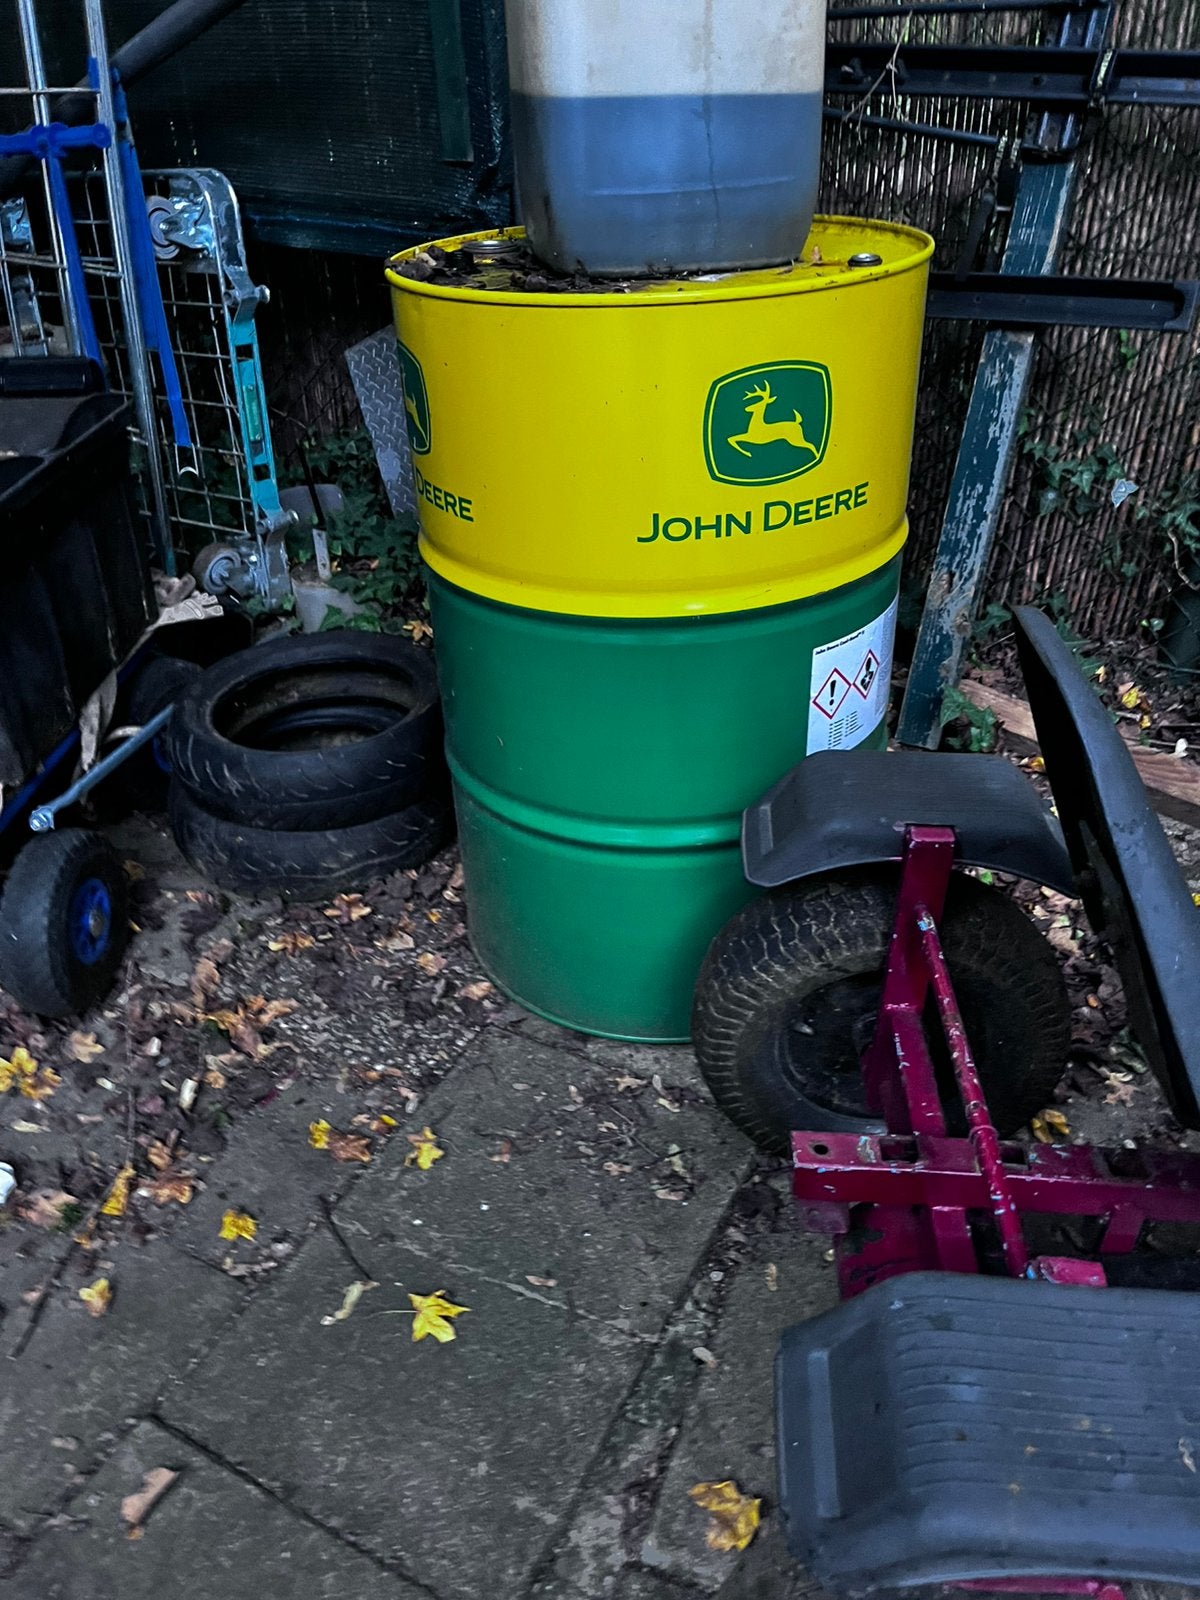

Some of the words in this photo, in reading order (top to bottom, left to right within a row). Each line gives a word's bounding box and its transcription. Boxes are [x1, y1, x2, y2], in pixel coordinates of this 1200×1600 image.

[415, 467, 474, 522] DEERE
[637, 511, 752, 543] JOHN
[763, 481, 869, 532] DEERE
